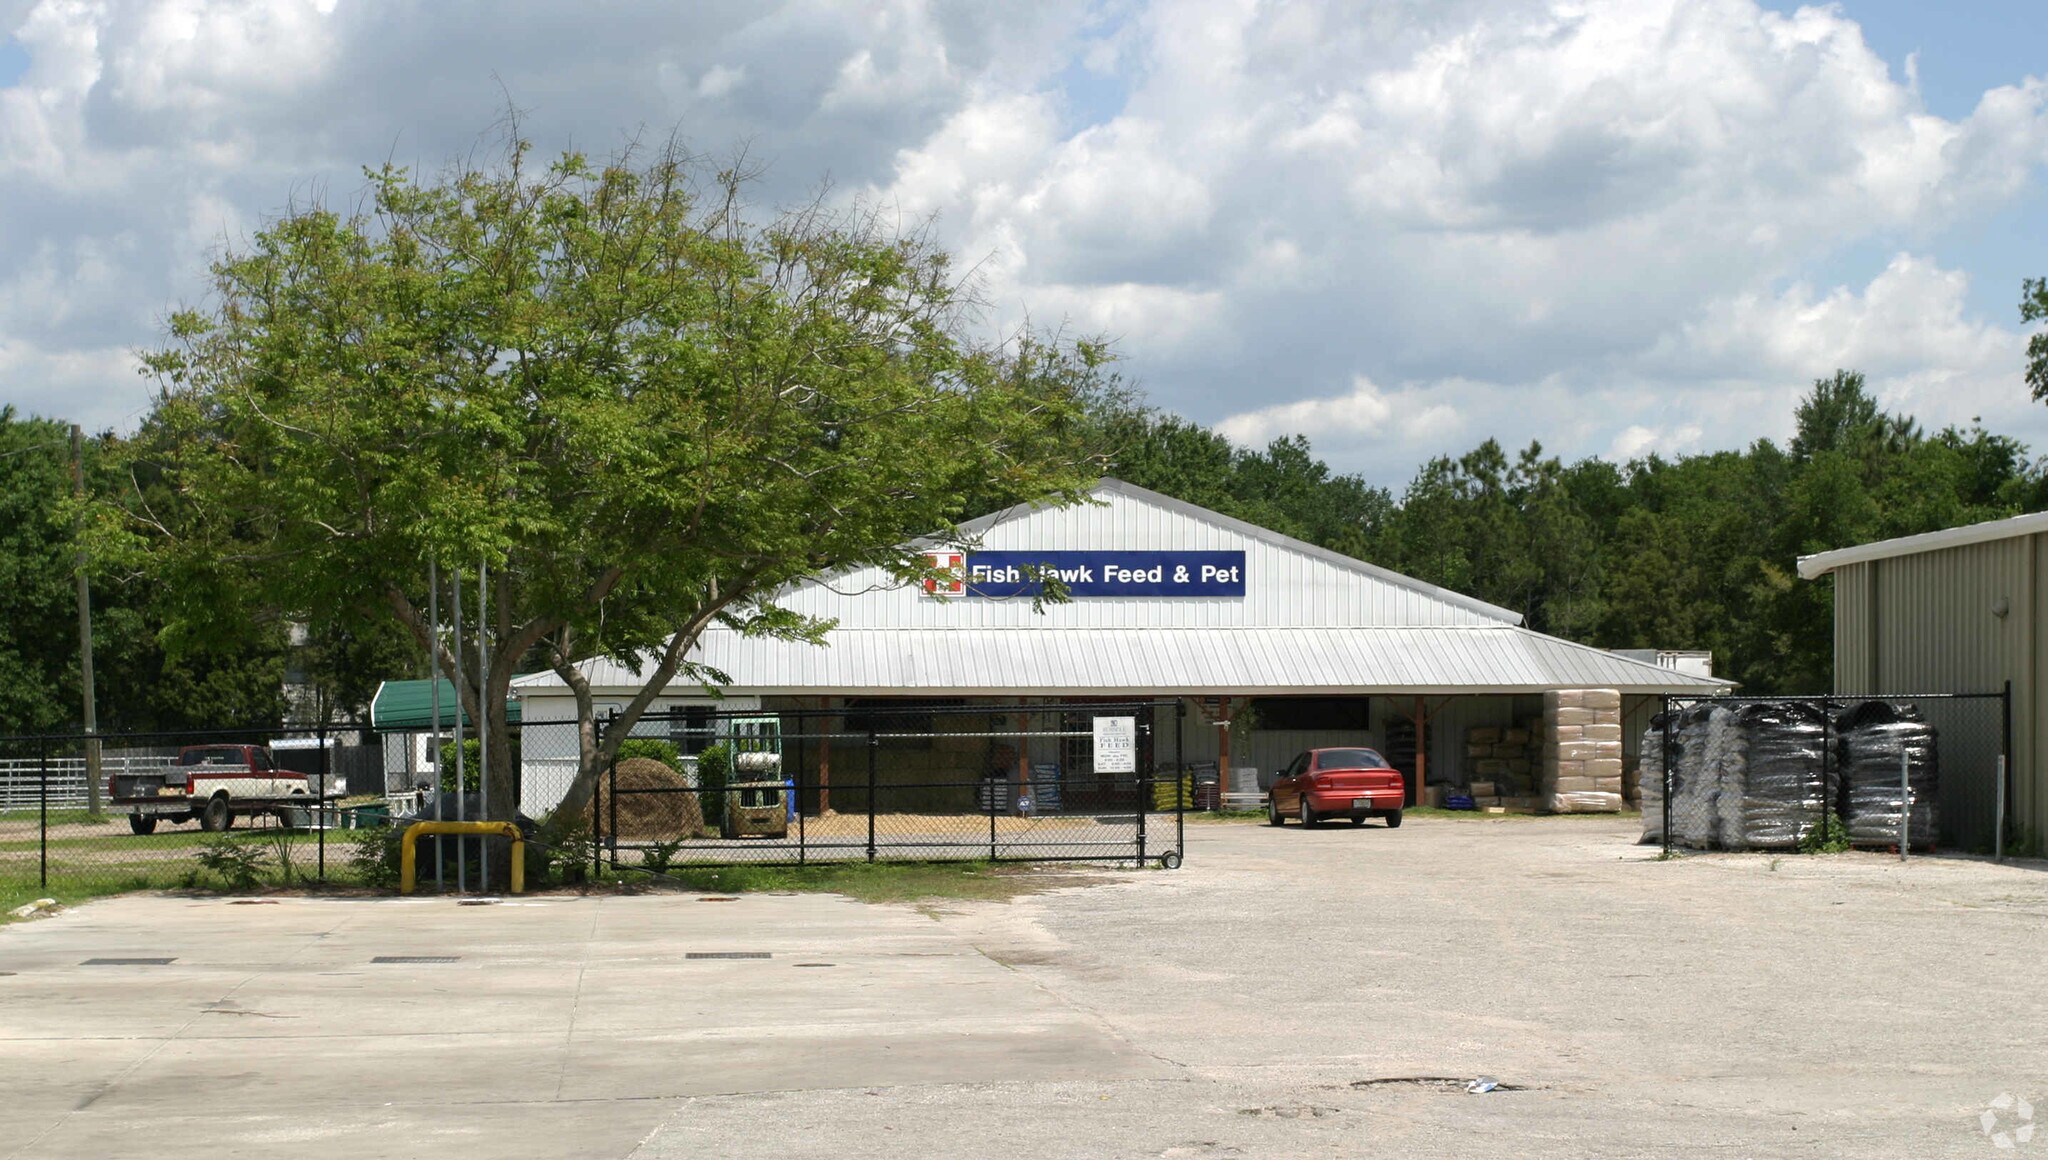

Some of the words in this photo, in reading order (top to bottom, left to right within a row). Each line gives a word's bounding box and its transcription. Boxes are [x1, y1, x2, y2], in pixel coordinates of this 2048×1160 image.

[972, 565, 1020, 583] Fish
[1104, 565, 1162, 583] Feed
[1173, 565, 1190, 583] &
[1201, 565, 1239, 583] Pet
